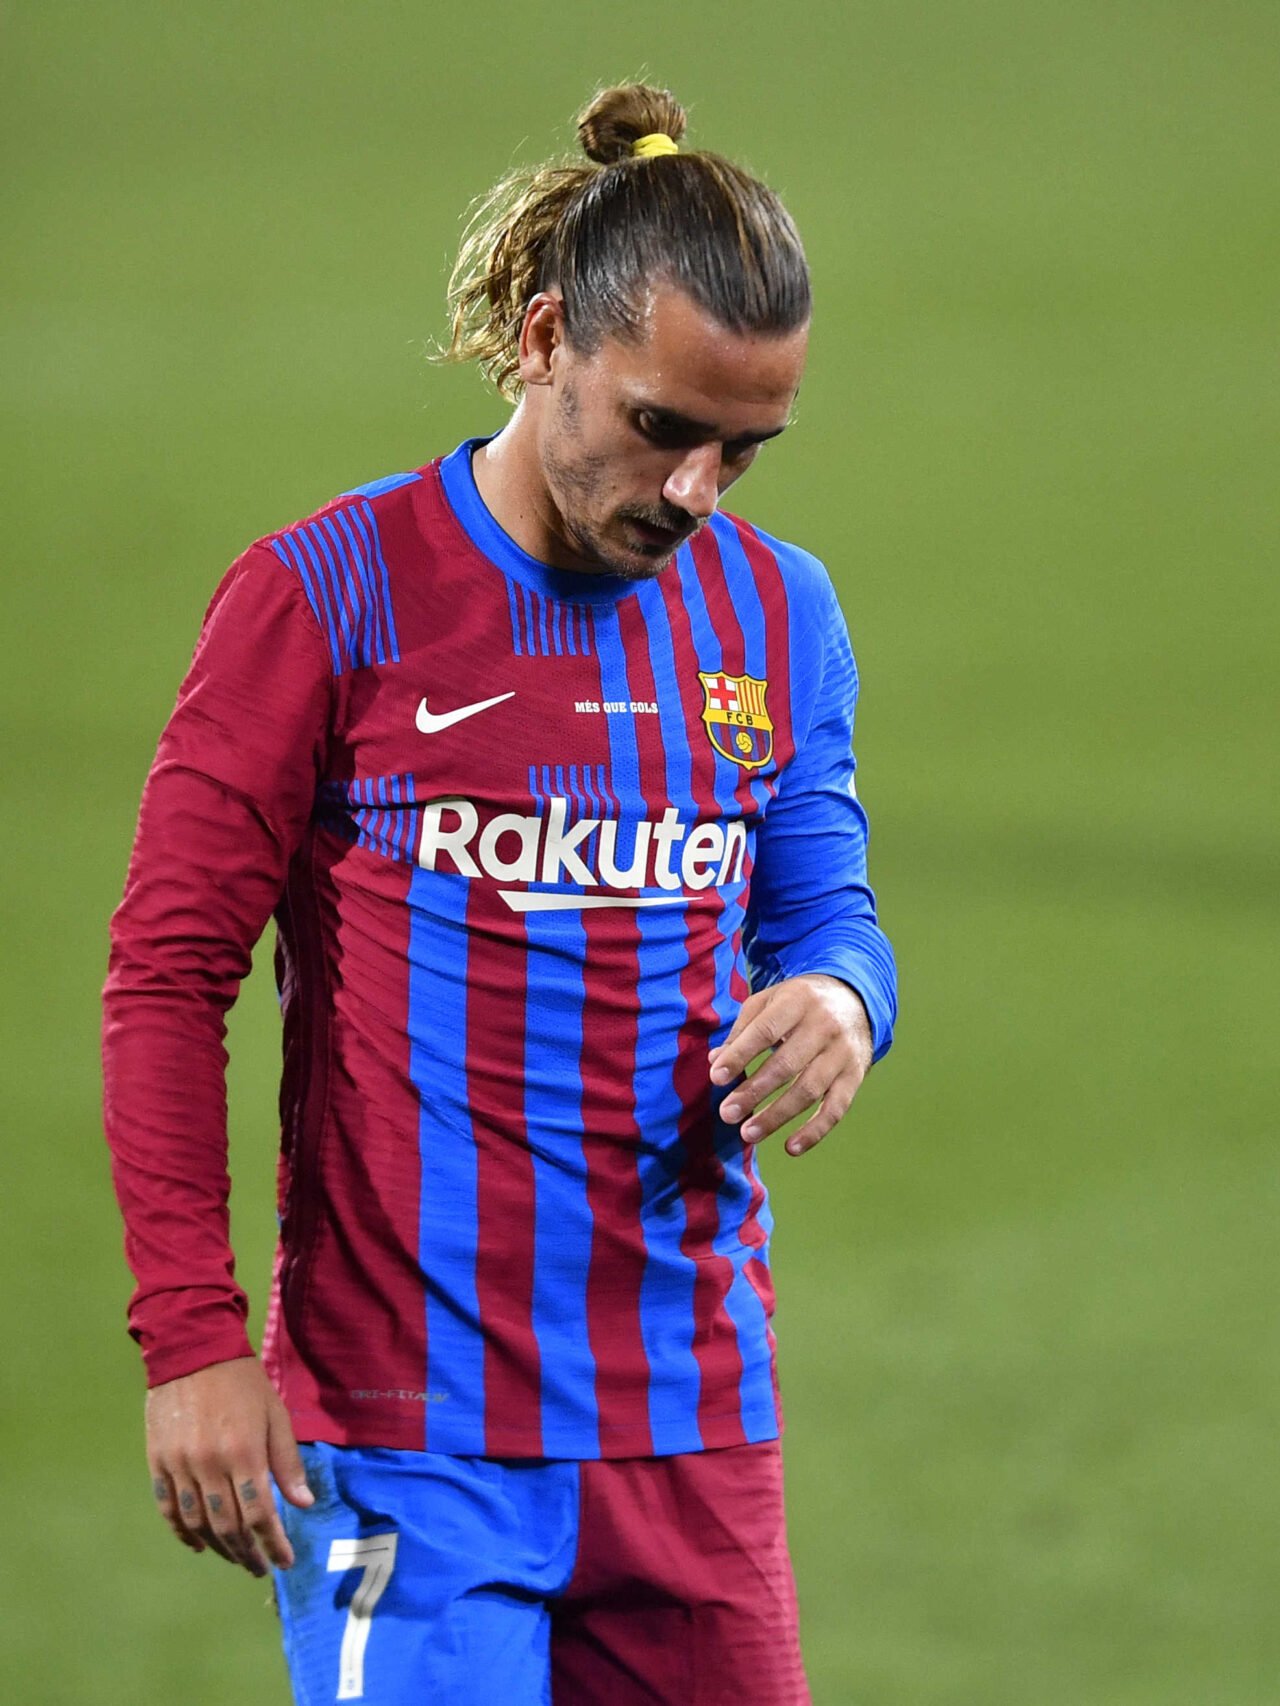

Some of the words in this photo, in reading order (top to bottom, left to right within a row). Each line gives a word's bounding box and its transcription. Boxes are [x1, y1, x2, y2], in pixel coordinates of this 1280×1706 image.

[574, 699, 600, 713] MÉS
[603, 702, 627, 713] QUE
[629, 702, 659, 714] GOLS
[726, 712, 753, 725] FCB
[418, 796, 747, 890] Rakuten
[326, 1532, 398, 1699] 7
